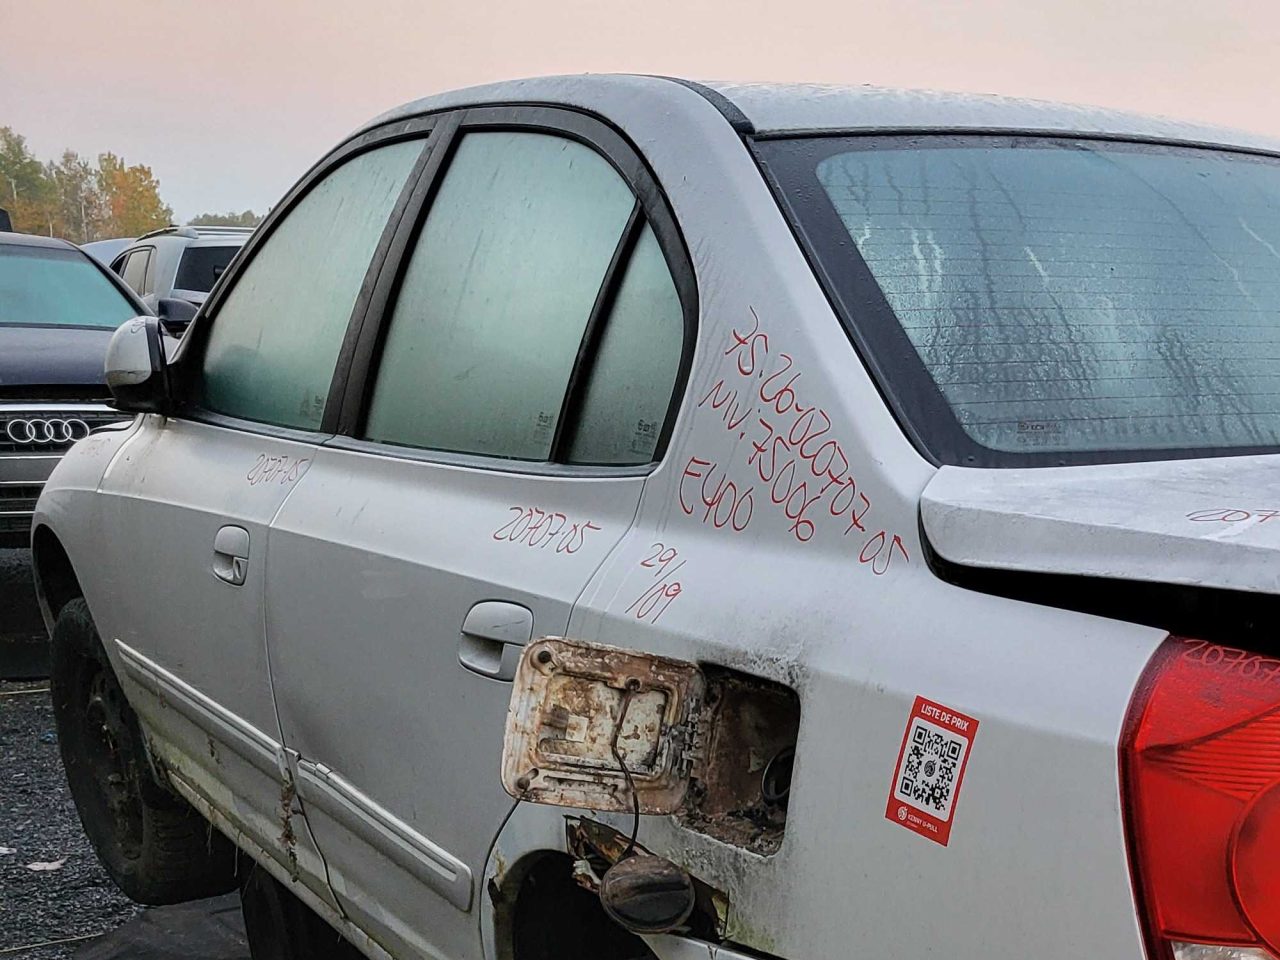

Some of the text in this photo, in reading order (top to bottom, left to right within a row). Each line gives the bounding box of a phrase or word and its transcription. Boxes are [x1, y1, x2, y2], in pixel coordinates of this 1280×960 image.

[920, 703, 970, 732] LISTE DE PRIX
